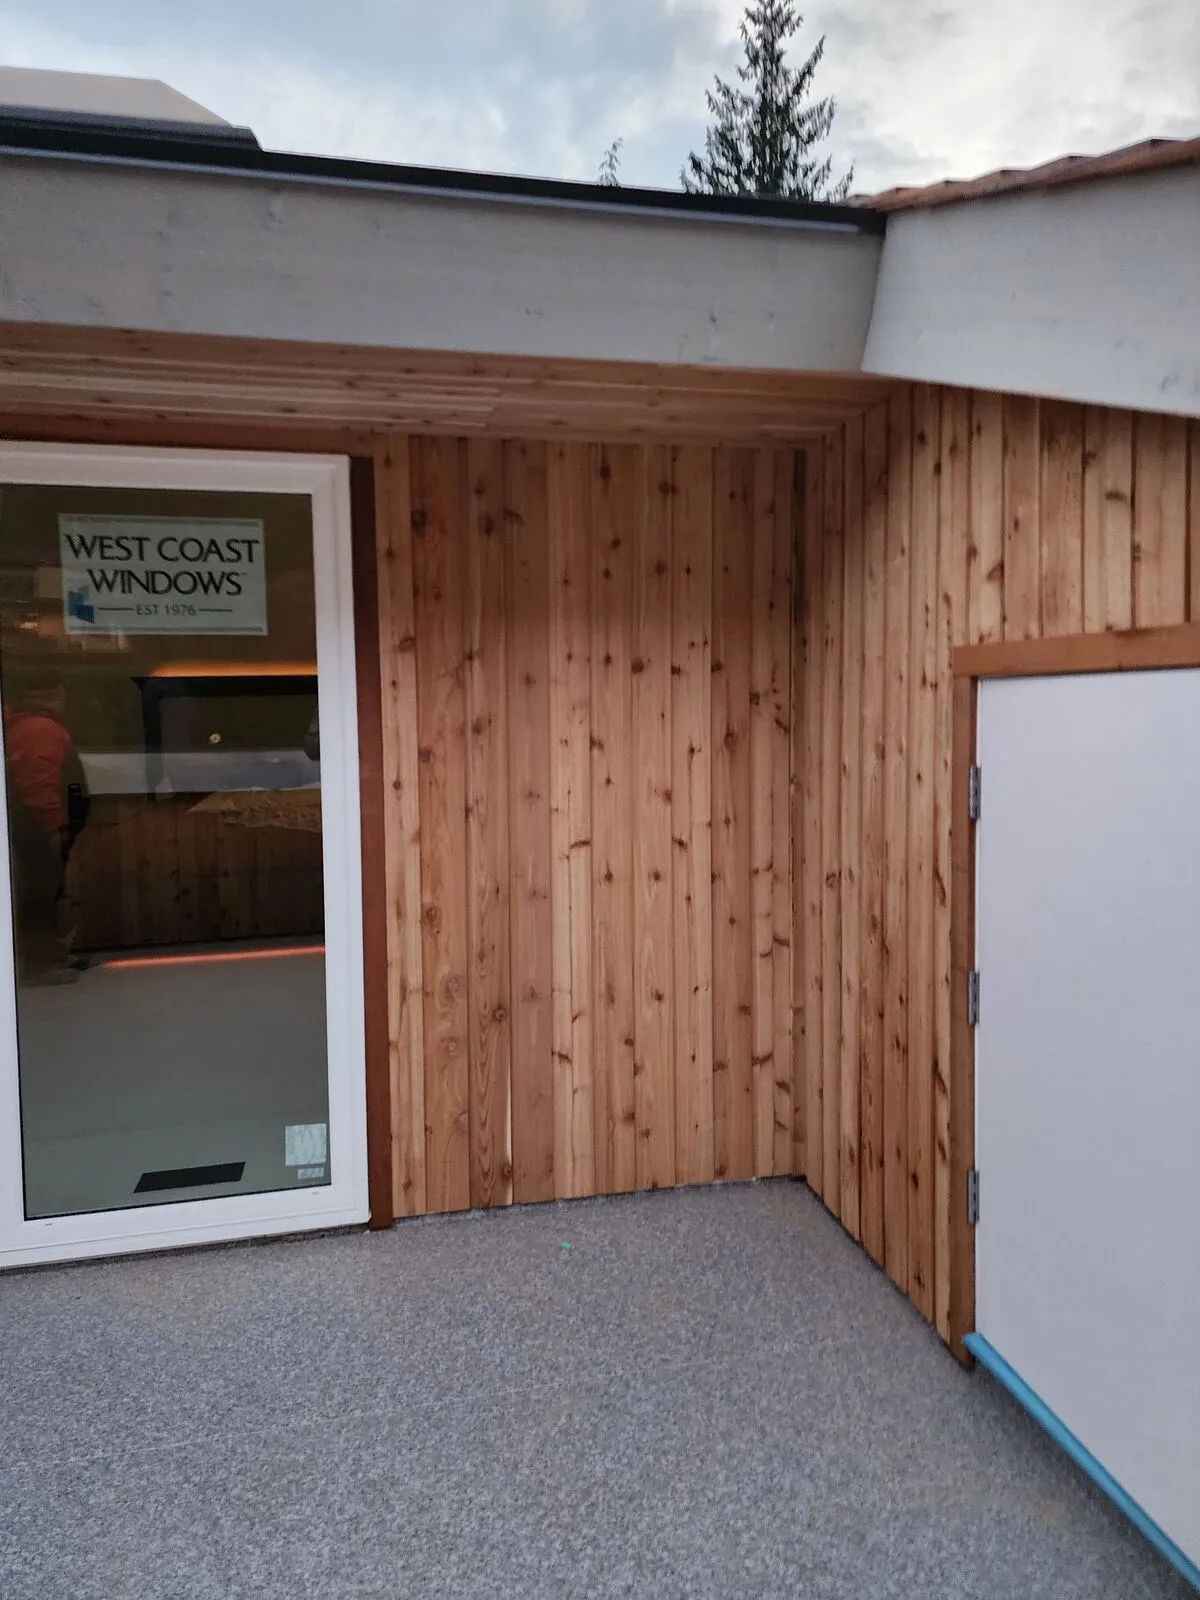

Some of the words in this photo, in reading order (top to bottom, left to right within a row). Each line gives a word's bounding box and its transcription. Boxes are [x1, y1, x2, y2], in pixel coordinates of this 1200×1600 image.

[63, 534, 149, 561] WEST
[157, 536, 260, 563] COAST
[87, 568, 242, 596] WINDOWS
[136, 605, 159, 616] EST
[165, 605, 196, 616] 1976
